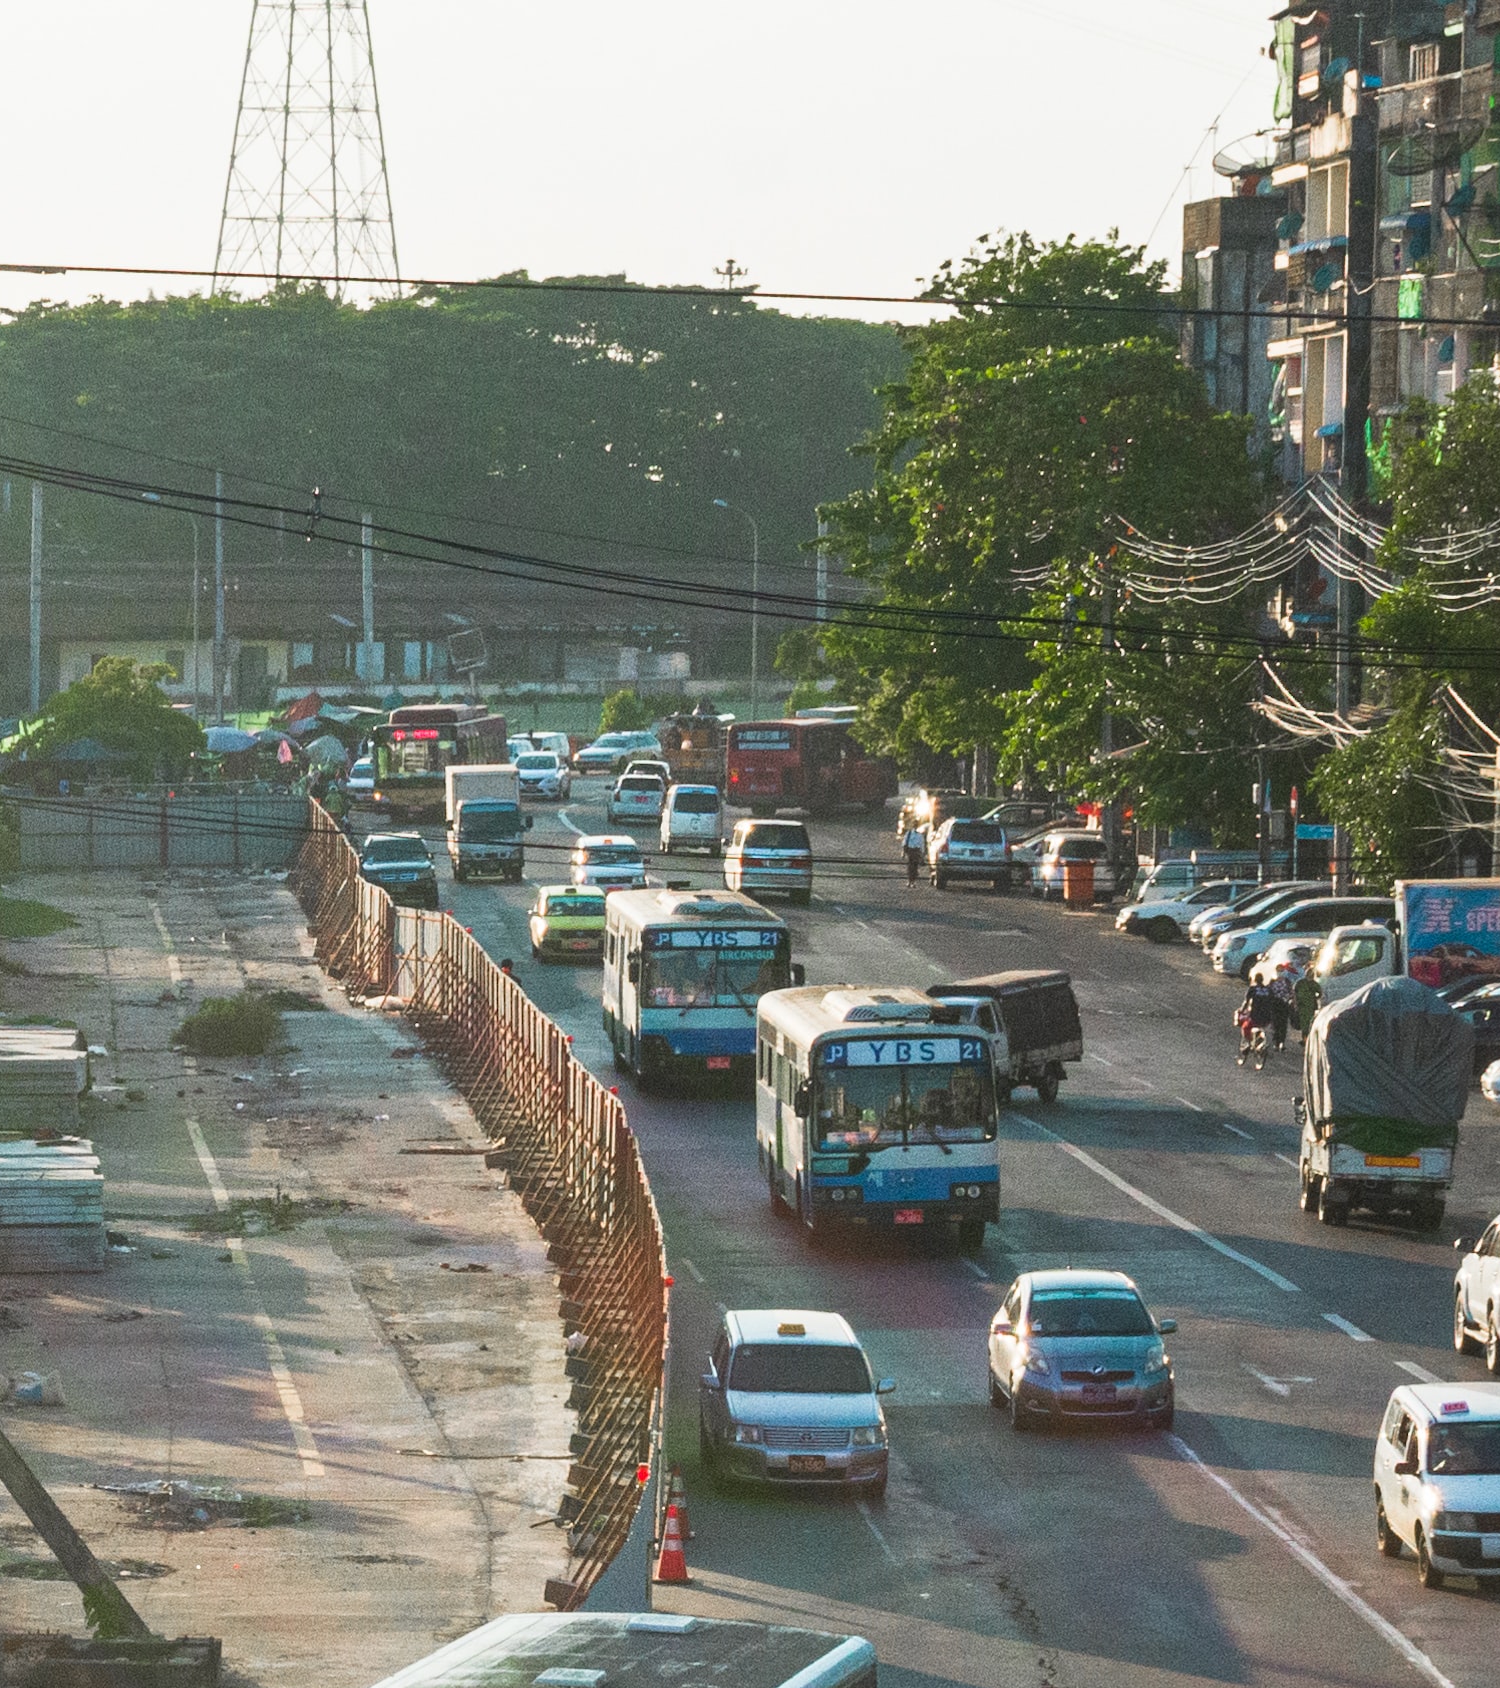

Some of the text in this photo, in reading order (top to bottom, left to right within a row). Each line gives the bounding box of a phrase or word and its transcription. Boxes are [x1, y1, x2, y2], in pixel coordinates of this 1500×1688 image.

[696, 931, 739, 947] YBS
[761, 933, 777, 946] 21
[870, 1042, 936, 1063] YBS
[962, 1043, 982, 1061] 21
